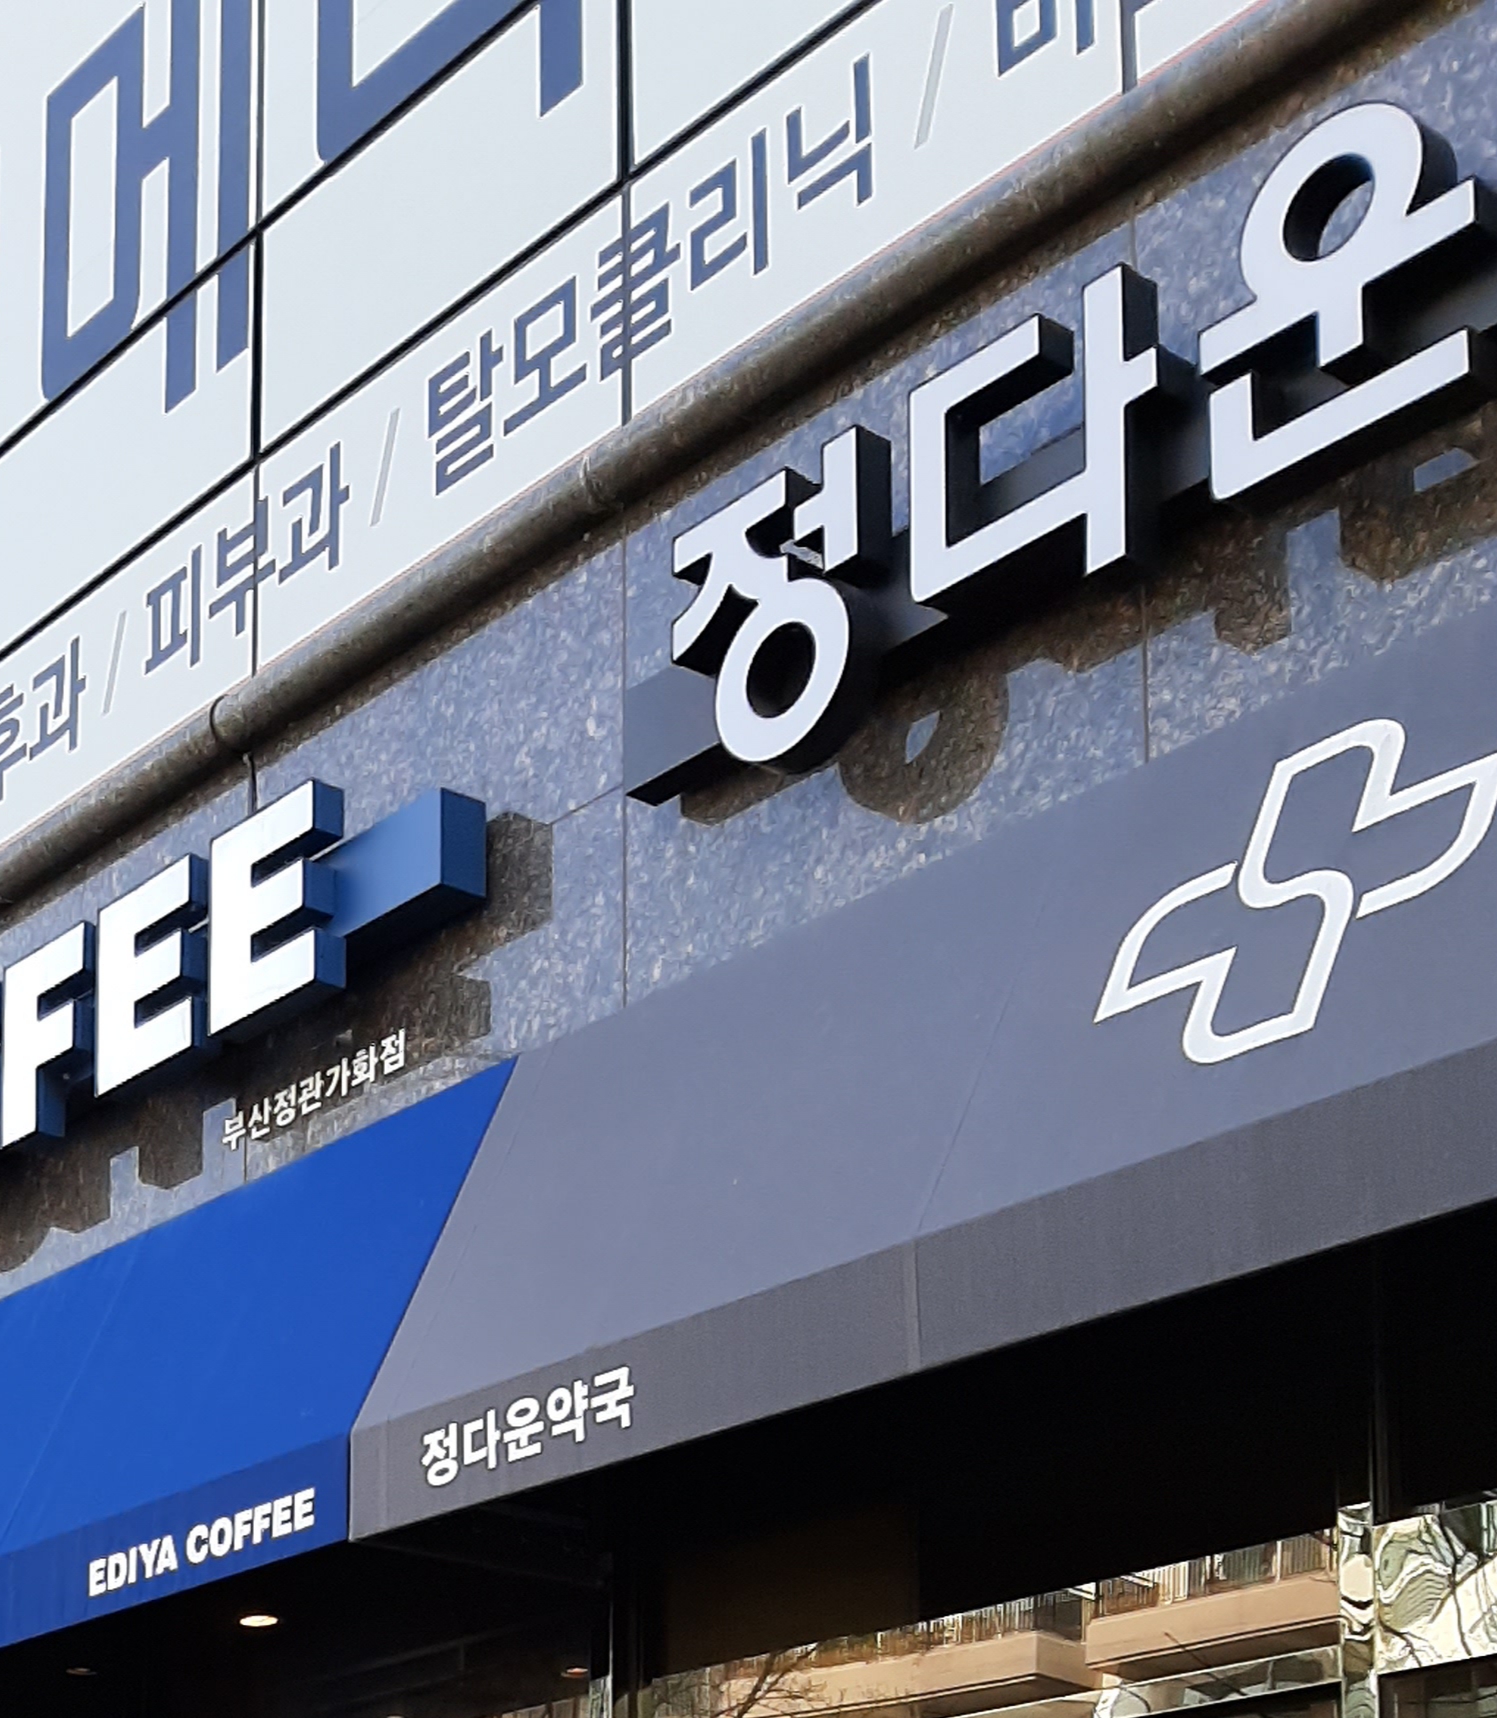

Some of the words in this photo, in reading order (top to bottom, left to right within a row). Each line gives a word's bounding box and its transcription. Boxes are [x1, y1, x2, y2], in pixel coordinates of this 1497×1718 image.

[144, 441, 350, 676] 피부과
[427, 51, 875, 497] 탈모클리닉
[672, 102, 1477, 763] 정다운
[221, 1028, 407, 1151] 부산정관가화점
[420, 1364, 635, 1488] 정다운약국
[87, 1533, 178, 1598] EDIYA
[185, 1487, 316, 1565] COFFEE
